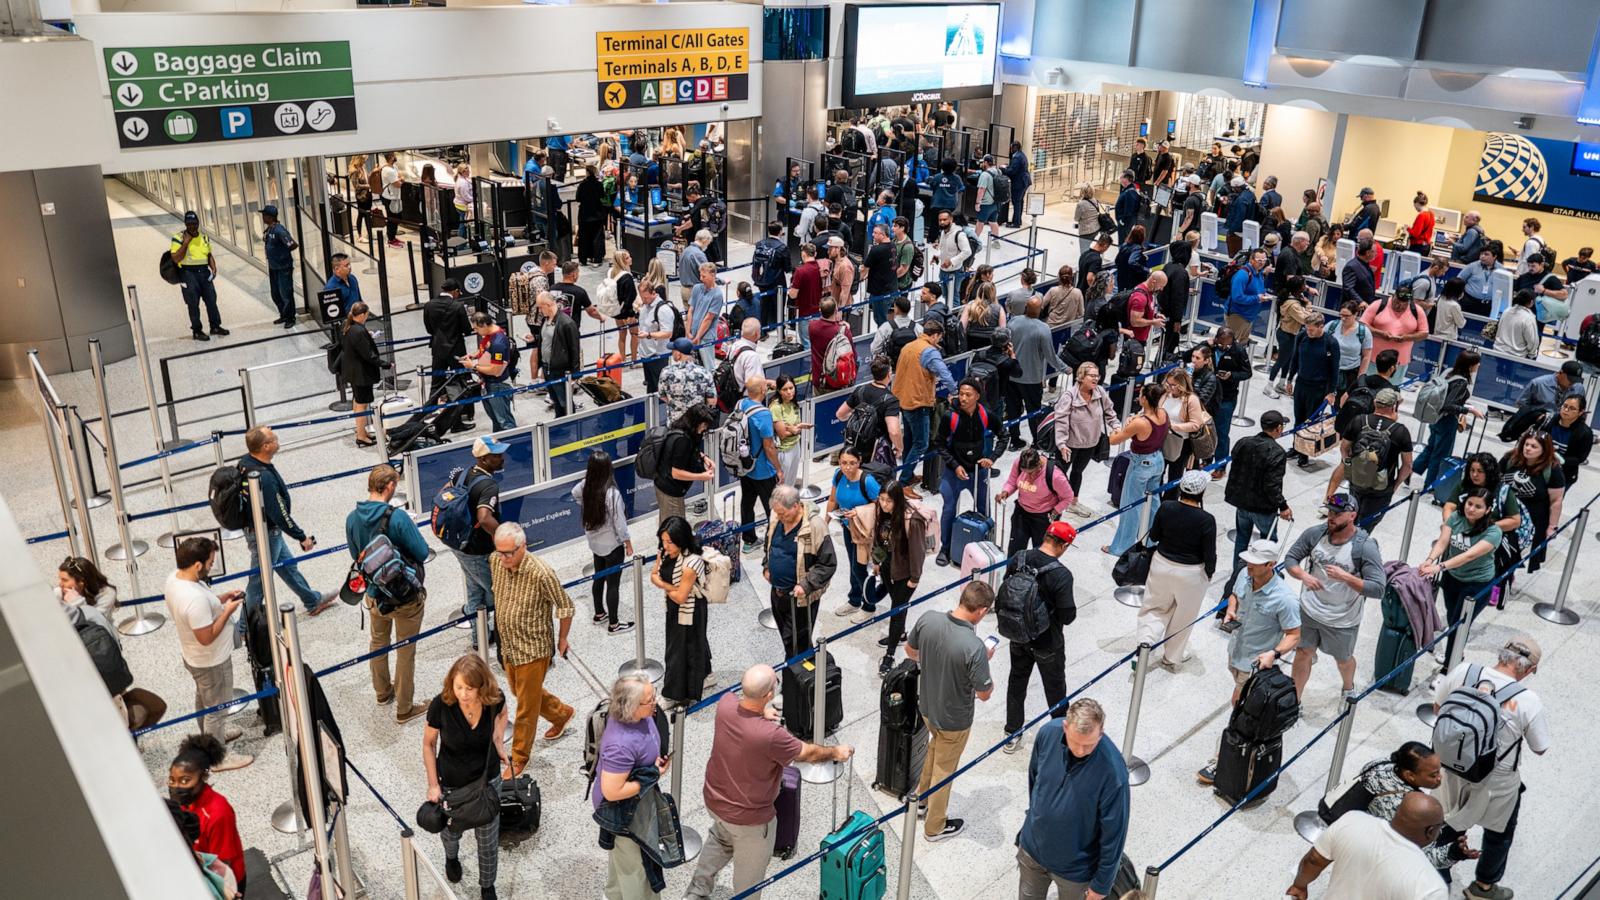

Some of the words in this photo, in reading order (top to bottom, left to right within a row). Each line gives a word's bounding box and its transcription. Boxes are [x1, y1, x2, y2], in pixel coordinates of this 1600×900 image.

[603, 34, 667, 52] Terminal
[671, 33, 703, 49] C/All
[706, 33, 744, 48] Gates
[153, 52, 256, 76] Baggage
[261, 47, 322, 67] Claim
[604, 58, 677, 76] Terminals
[681, 58, 696, 73] A,
[700, 57, 713, 72] B,
[717, 56, 731, 71] D,
[735, 55, 742, 69] E
[158, 79, 270, 102] C-Parking
[643, 83, 657, 100] A
[662, 80, 674, 98] B
[678, 79, 692, 98] C
[696, 78, 710, 96] D
[714, 77, 726, 95] E
[911, 92, 942, 102] JCDecaux
[227, 111, 246, 134] P
[1552, 207, 1575, 217] STAR
[1575, 211, 1600, 221] ALLIA
[531, 517, 545, 525] More
[545, 509, 571, 521] Exploring
